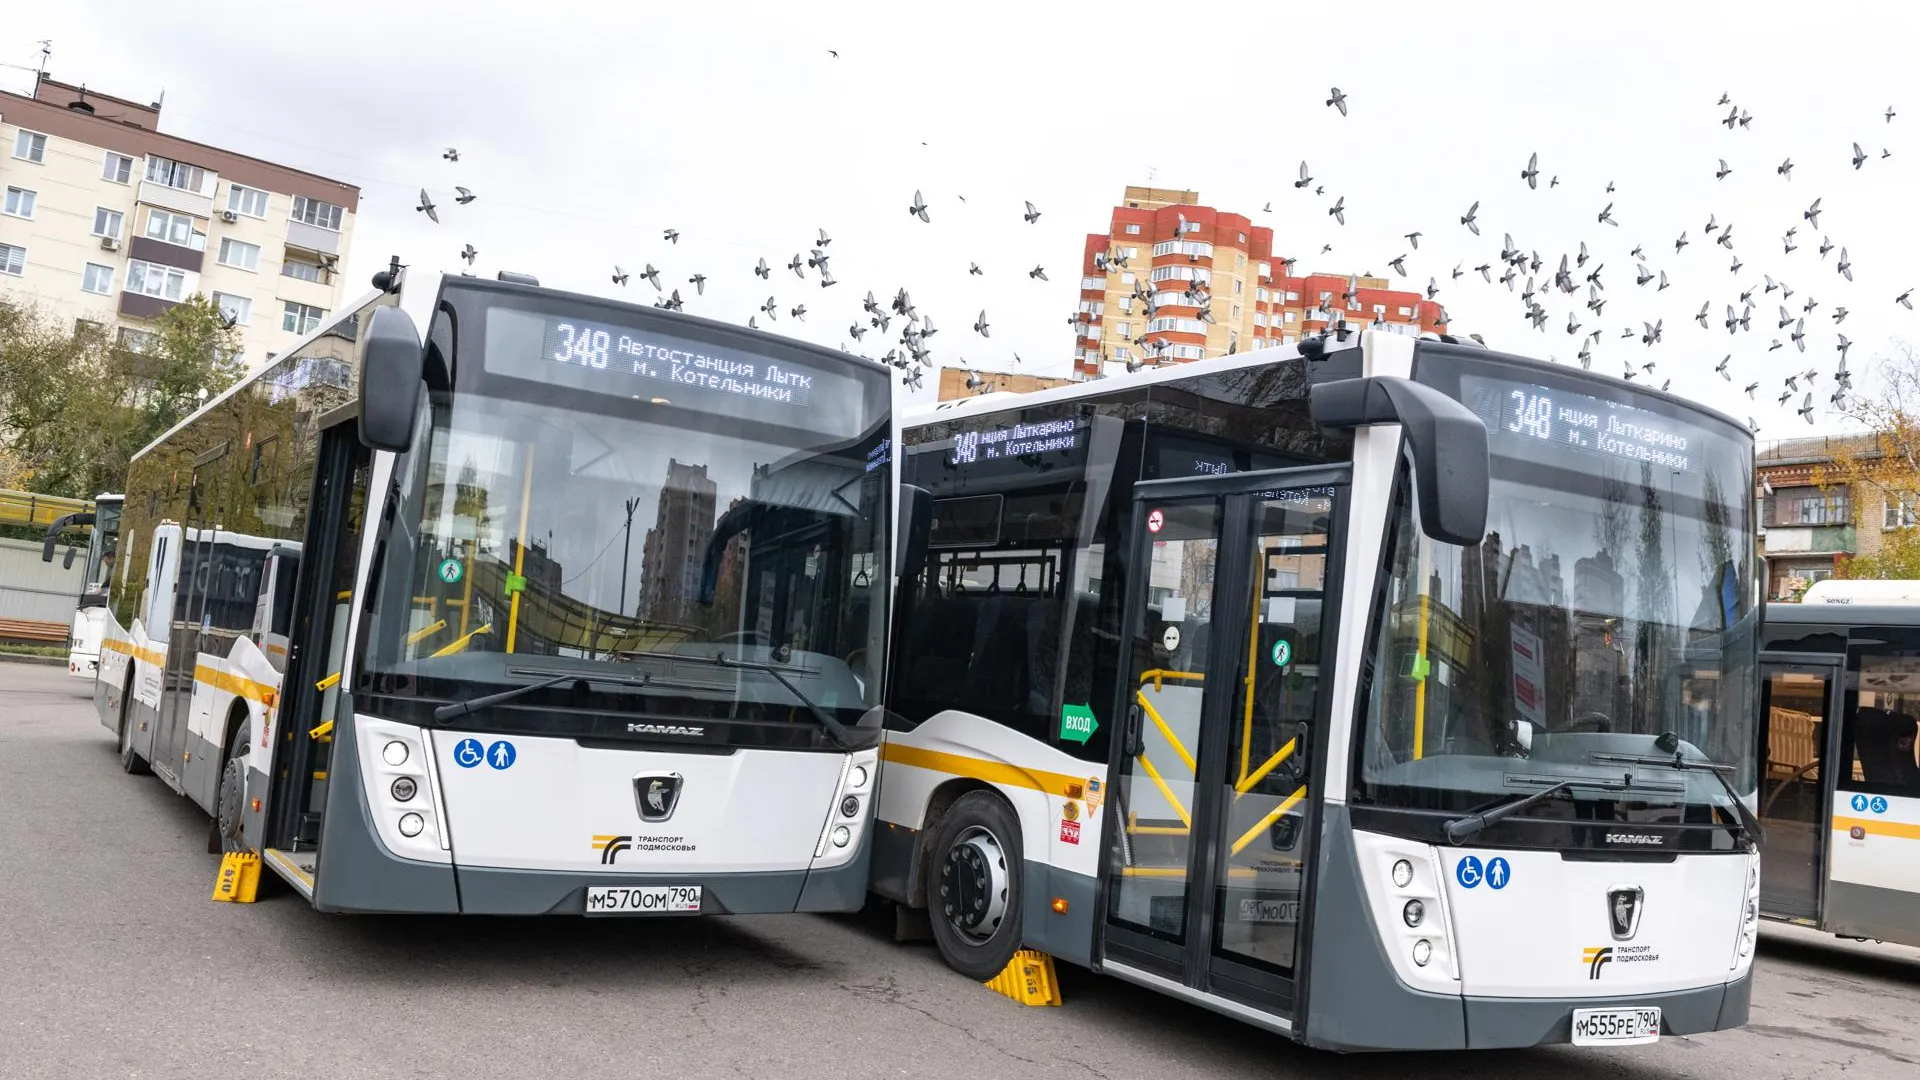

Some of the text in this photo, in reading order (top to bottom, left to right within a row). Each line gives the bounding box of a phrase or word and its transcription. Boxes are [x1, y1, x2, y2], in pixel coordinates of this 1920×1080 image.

[555, 323, 812, 389] 348 Автостанция Лытк
[671, 360, 791, 402] Котельники
[1508, 390, 1687, 451] 348 нция Лыткарино
[952, 420, 1075, 464] 348 нция Лыткарино
[1005, 436, 1075, 456] Котельники
[1597, 432, 1688, 470] Котельники
[627, 723, 704, 736] KAMAZ
[1065, 715, 1091, 733] ВХОД
[1605, 833, 1663, 844] KAMAZ
[670, 888, 696, 903] 790
[1616, 954, 1659, 962] ПОДМОСКОВЬЯ
[1637, 1012, 1657, 1029] 790
